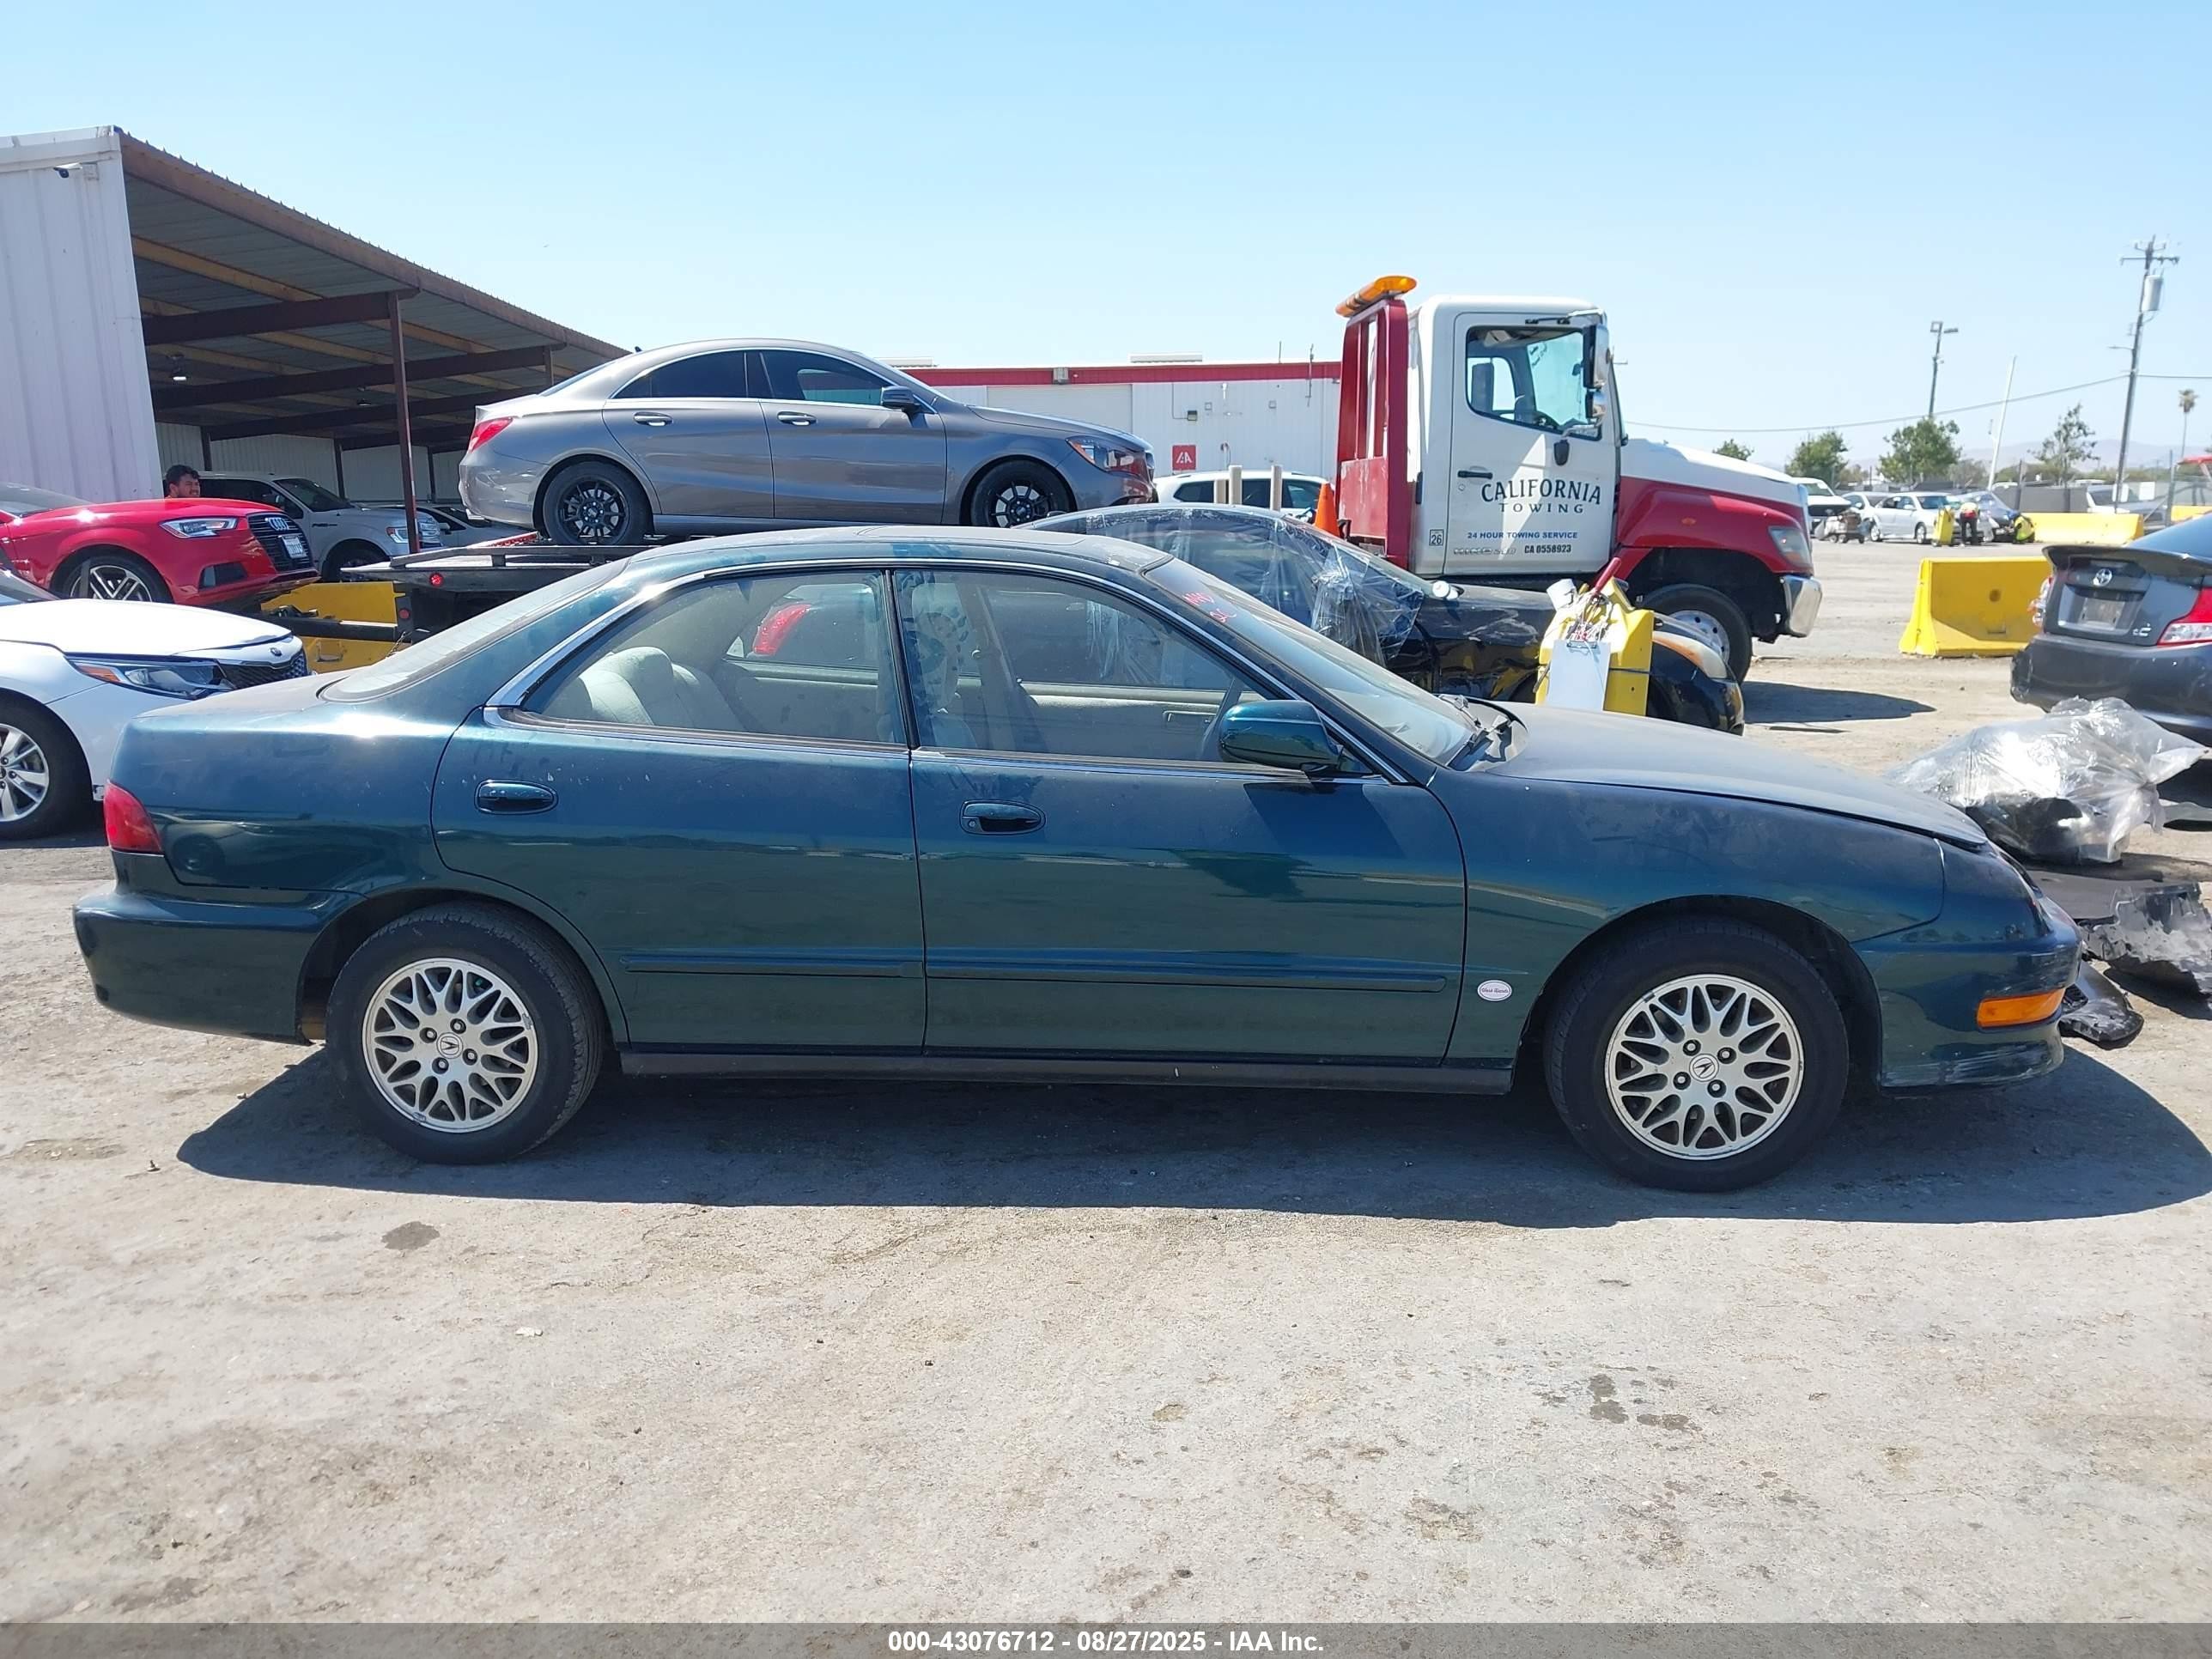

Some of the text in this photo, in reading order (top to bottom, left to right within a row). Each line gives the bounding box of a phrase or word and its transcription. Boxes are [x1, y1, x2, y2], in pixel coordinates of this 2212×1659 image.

[1481, 478, 1601, 505] CALIFORNIA
[1498, 502, 1583, 514] TOWING
[1431, 534, 1443, 544] 26
[1524, 544, 1534, 554] CA
[1535, 544, 1572, 554] 0558923
